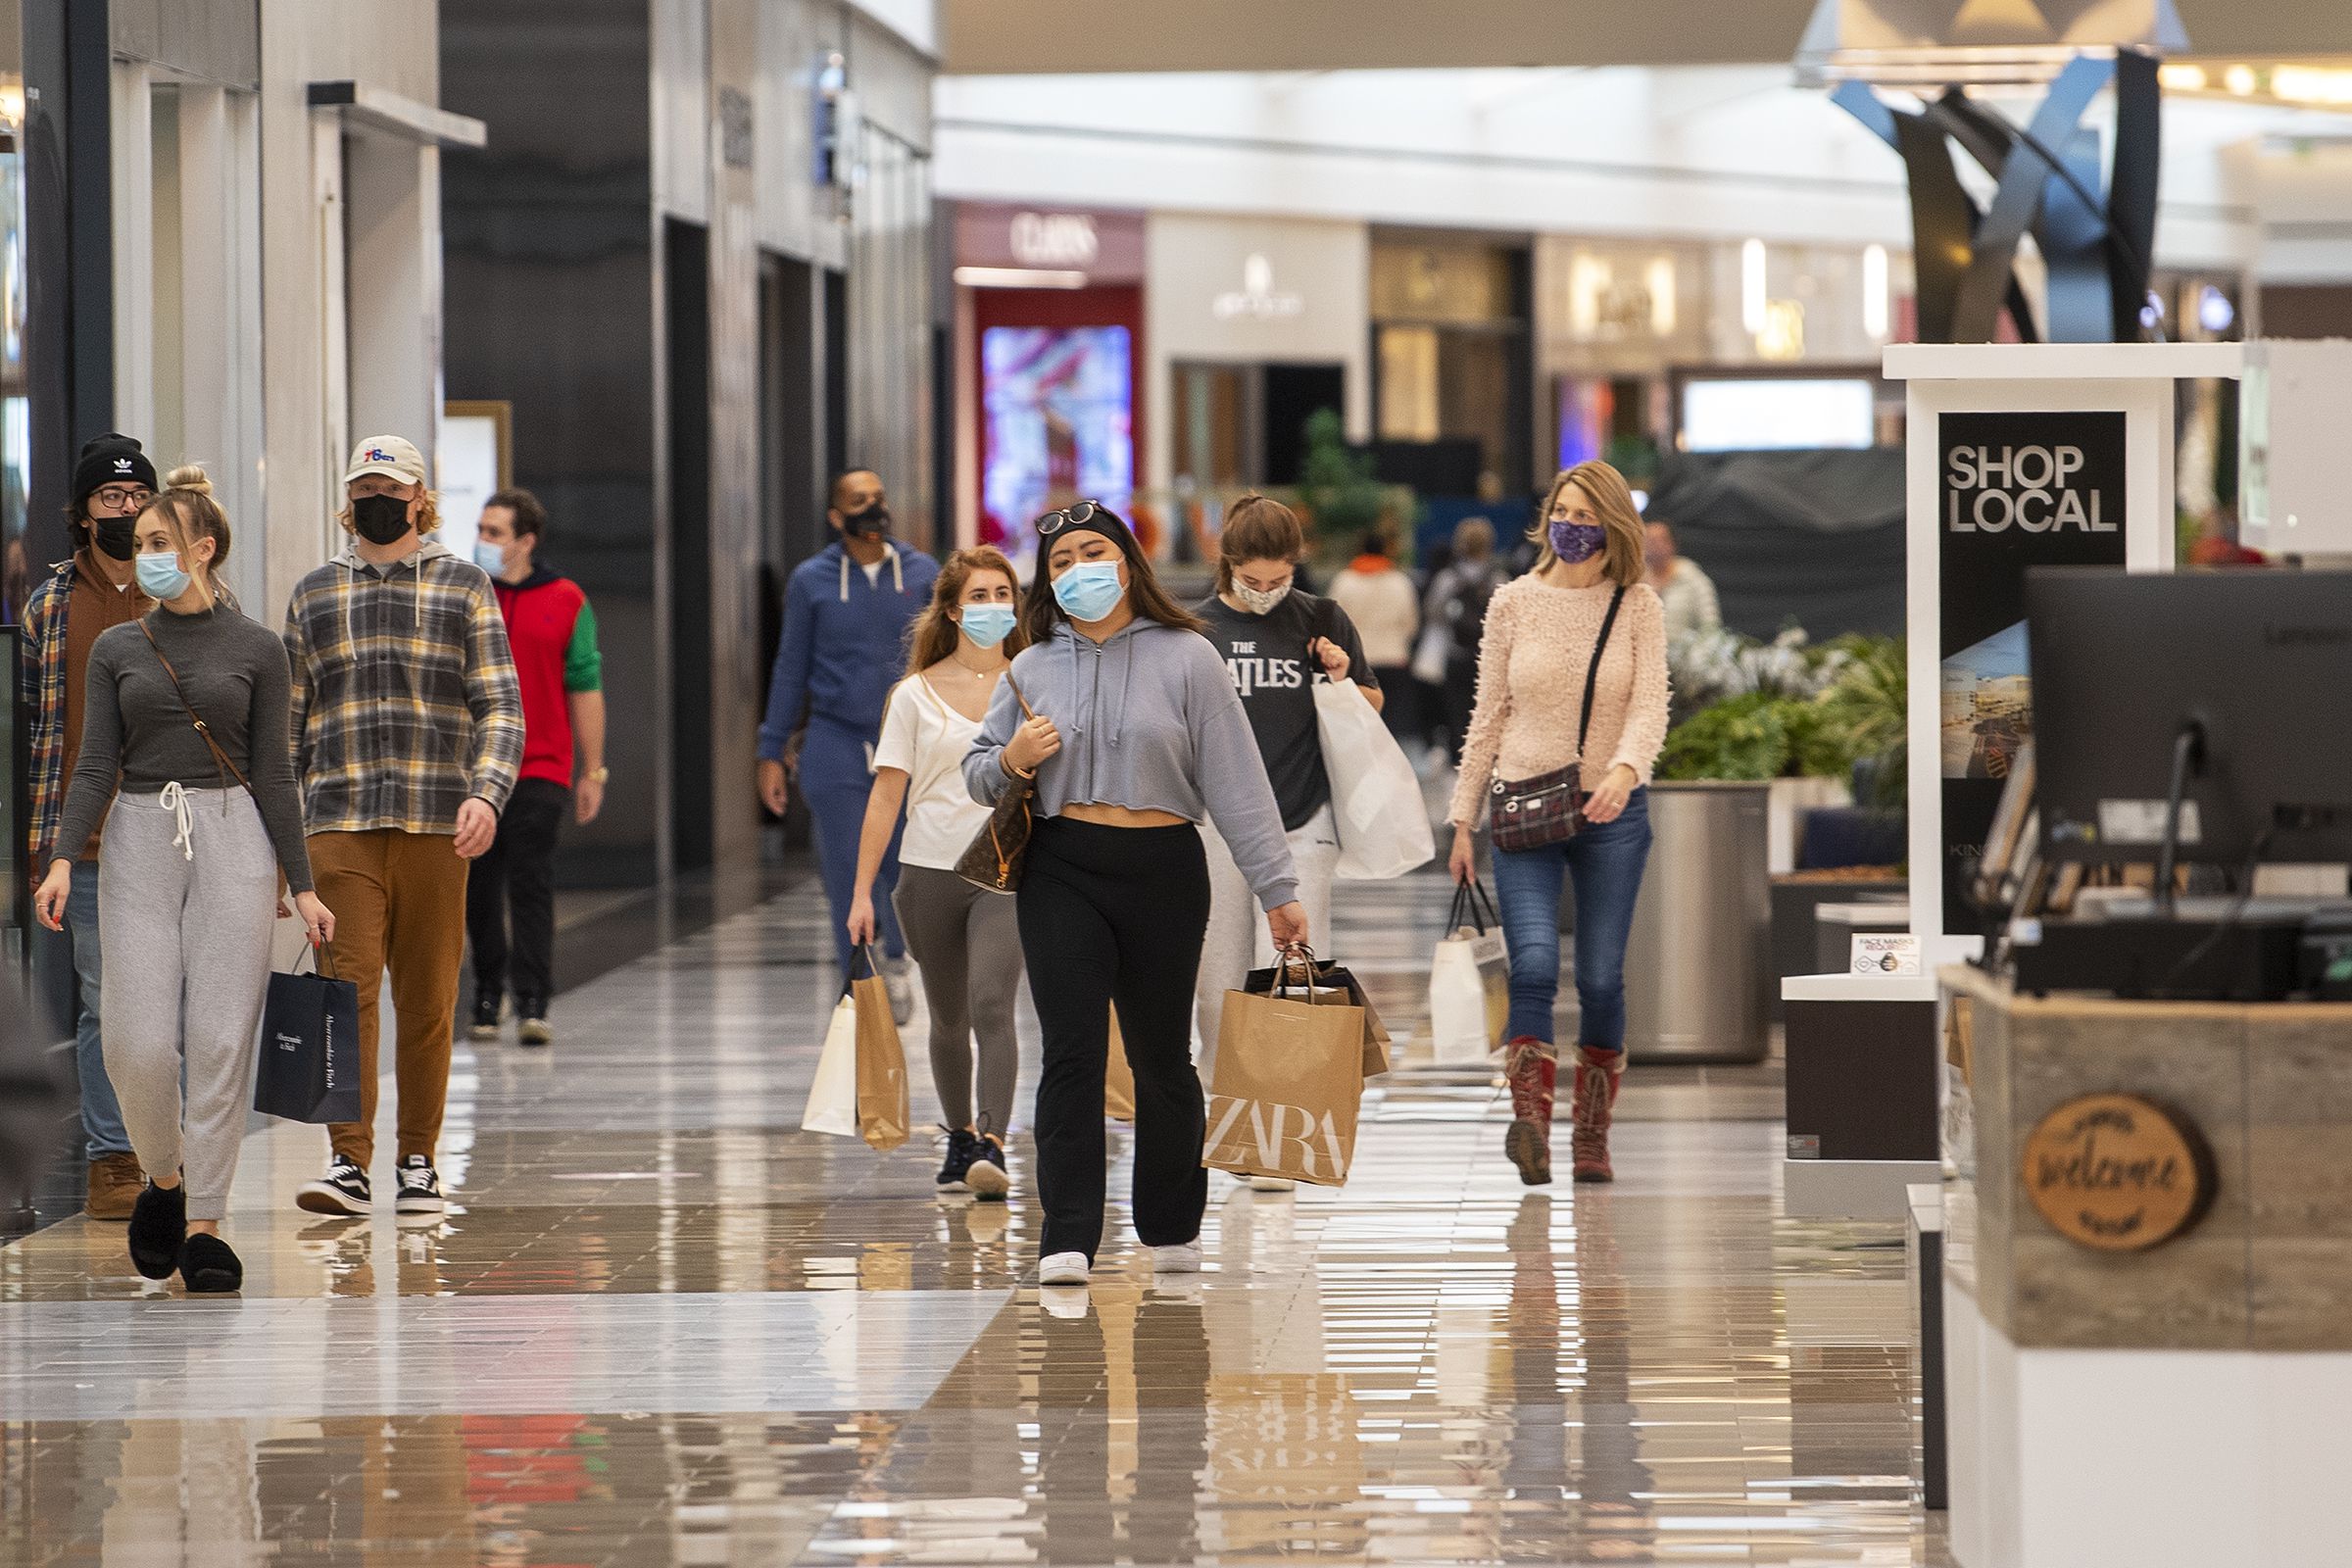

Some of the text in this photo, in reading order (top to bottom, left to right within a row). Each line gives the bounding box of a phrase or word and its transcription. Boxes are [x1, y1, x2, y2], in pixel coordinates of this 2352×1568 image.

[1947, 445, 2084, 489] SHOP
[1949, 488, 2118, 533] LOCAL
[1231, 641, 1257, 654] THE
[1949, 844, 1983, 857] KIN
[1202, 1094, 1347, 1179] ZARA
[2037, 1127, 2176, 1192] welcome
